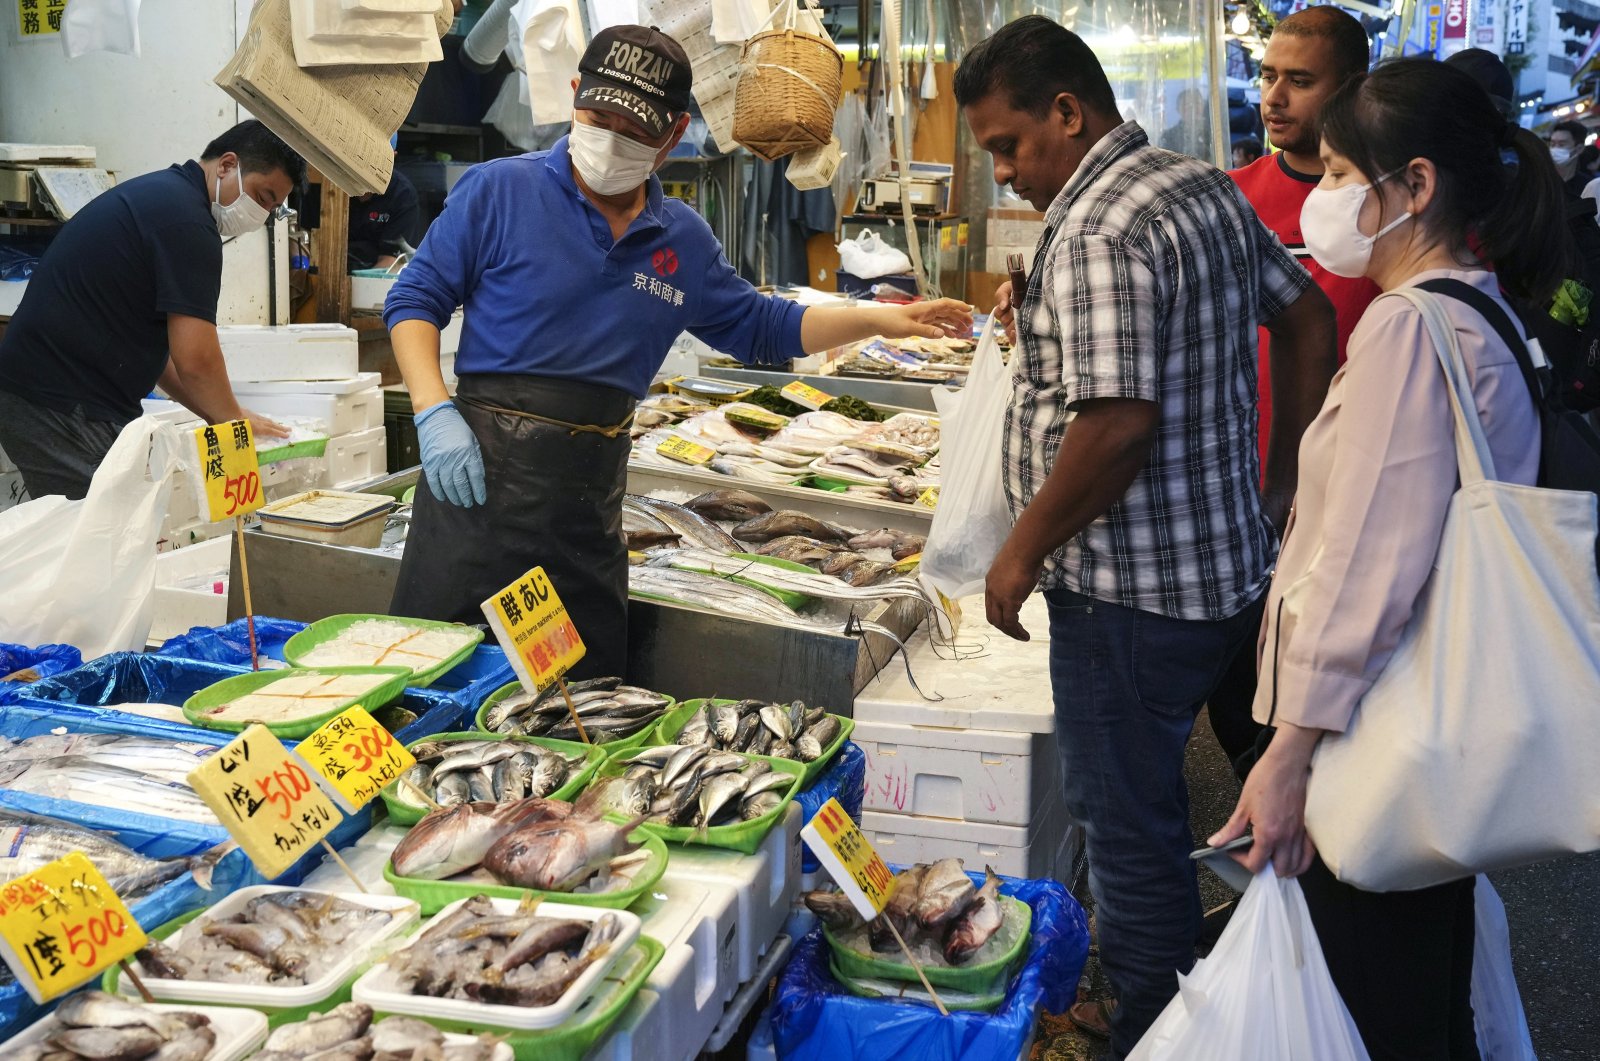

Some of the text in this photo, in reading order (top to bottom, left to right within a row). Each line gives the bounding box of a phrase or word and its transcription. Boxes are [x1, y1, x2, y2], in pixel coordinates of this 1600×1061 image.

[603, 40, 674, 87] FORZA!!
[604, 67, 632, 82] passo
[633, 75, 665, 97] leggero
[580, 86, 664, 133] SETTANTATRE
[595, 95, 647, 123] ITALIA
[632, 272, 686, 307] 京和商事
[223, 471, 259, 516] 500
[500, 574, 549, 627] 鮮あじ
[220, 739, 250, 774] ムツ
[343, 725, 394, 773] 300
[255, 760, 311, 821] 500
[61, 909, 125, 968] 500
